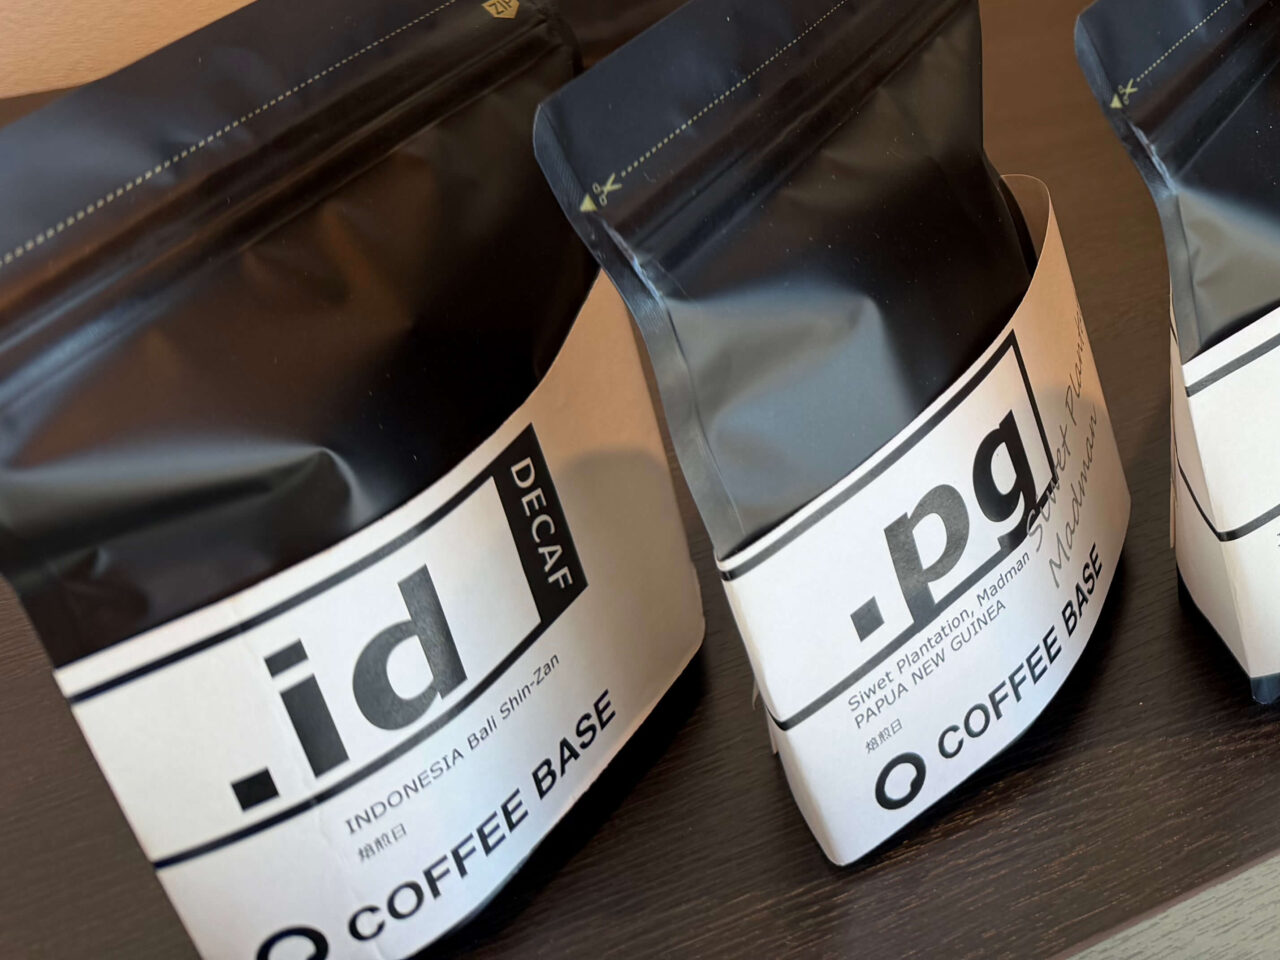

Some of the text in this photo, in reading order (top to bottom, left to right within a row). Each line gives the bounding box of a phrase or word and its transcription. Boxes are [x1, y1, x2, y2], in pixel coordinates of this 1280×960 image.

[510, 456, 574, 590] DECAF
[849, 409, 1040, 642] .pg
[230, 563, 468, 813] .id
[847, 552, 1031, 712] Siwet Plantation, Madman
[854, 599, 1007, 730] PAPUA NEW GUINEA
[938, 542, 1103, 759] COFFEE BASE
[344, 653, 560, 835] INDONESIA Bali Shin-Zan
[348, 688, 617, 942] COFFEE BASE
[865, 718, 903, 754] 焙煎日
